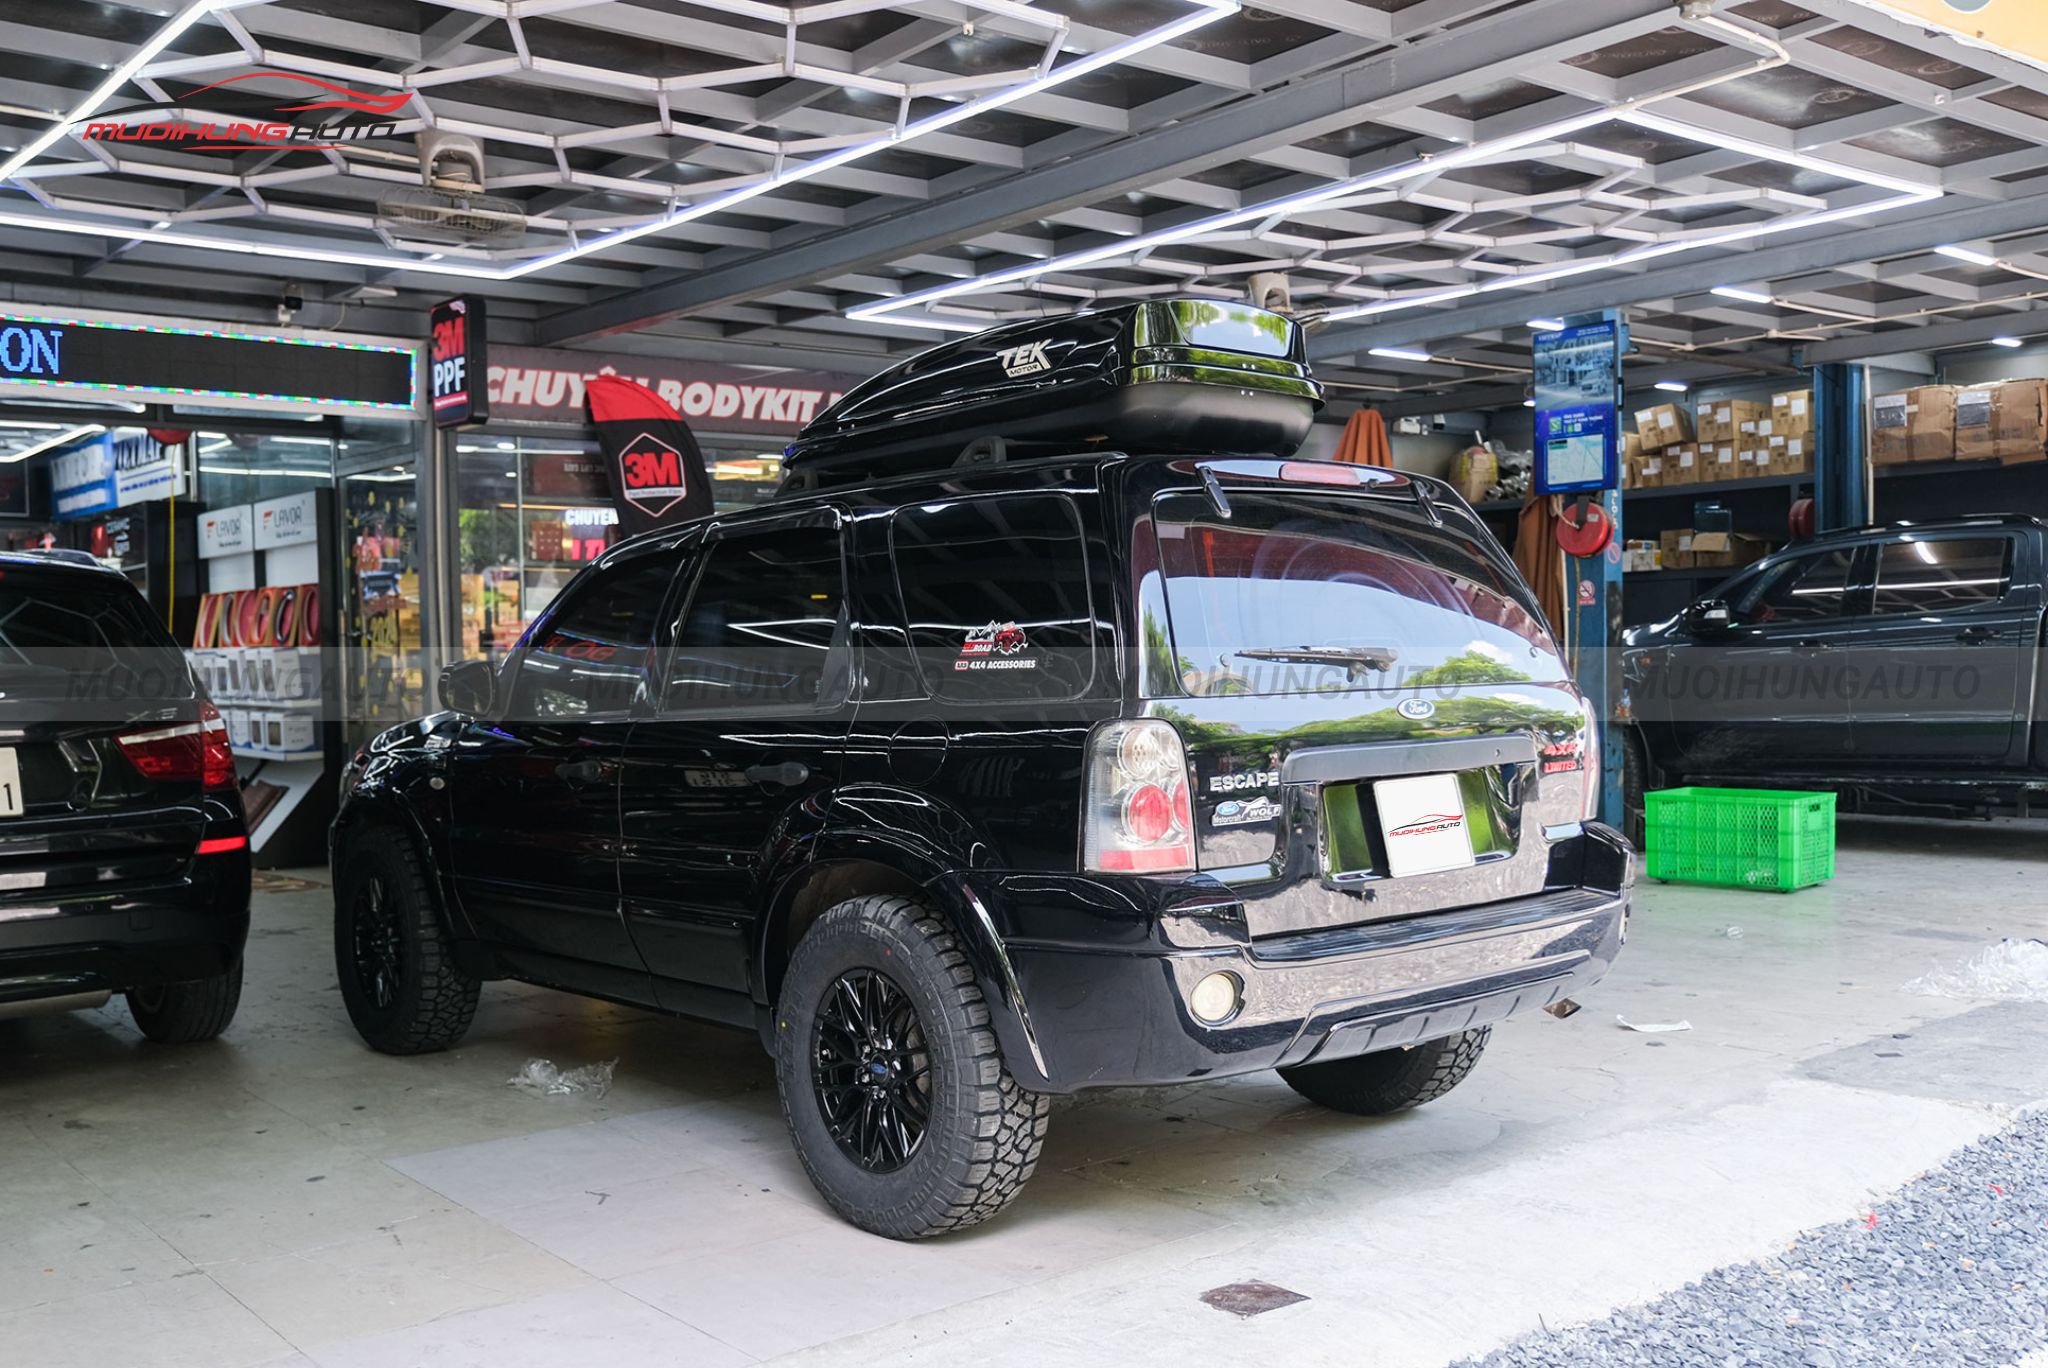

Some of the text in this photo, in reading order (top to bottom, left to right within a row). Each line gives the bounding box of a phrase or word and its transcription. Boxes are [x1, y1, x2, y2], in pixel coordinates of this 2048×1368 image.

[0, 326, 63, 375] ON
[432, 316, 465, 362] 3M
[996, 338, 1053, 370] TEK
[433, 356, 466, 398] PPF
[1009, 364, 1039, 376] MOTOR
[656, 378, 823, 423] BODYKIT
[624, 452, 680, 488] 3M
[987, 660, 1036, 669] ACCESSORIES
[1209, 771, 1280, 792] ESCAPE
[1544, 760, 1578, 774] LIMITED
